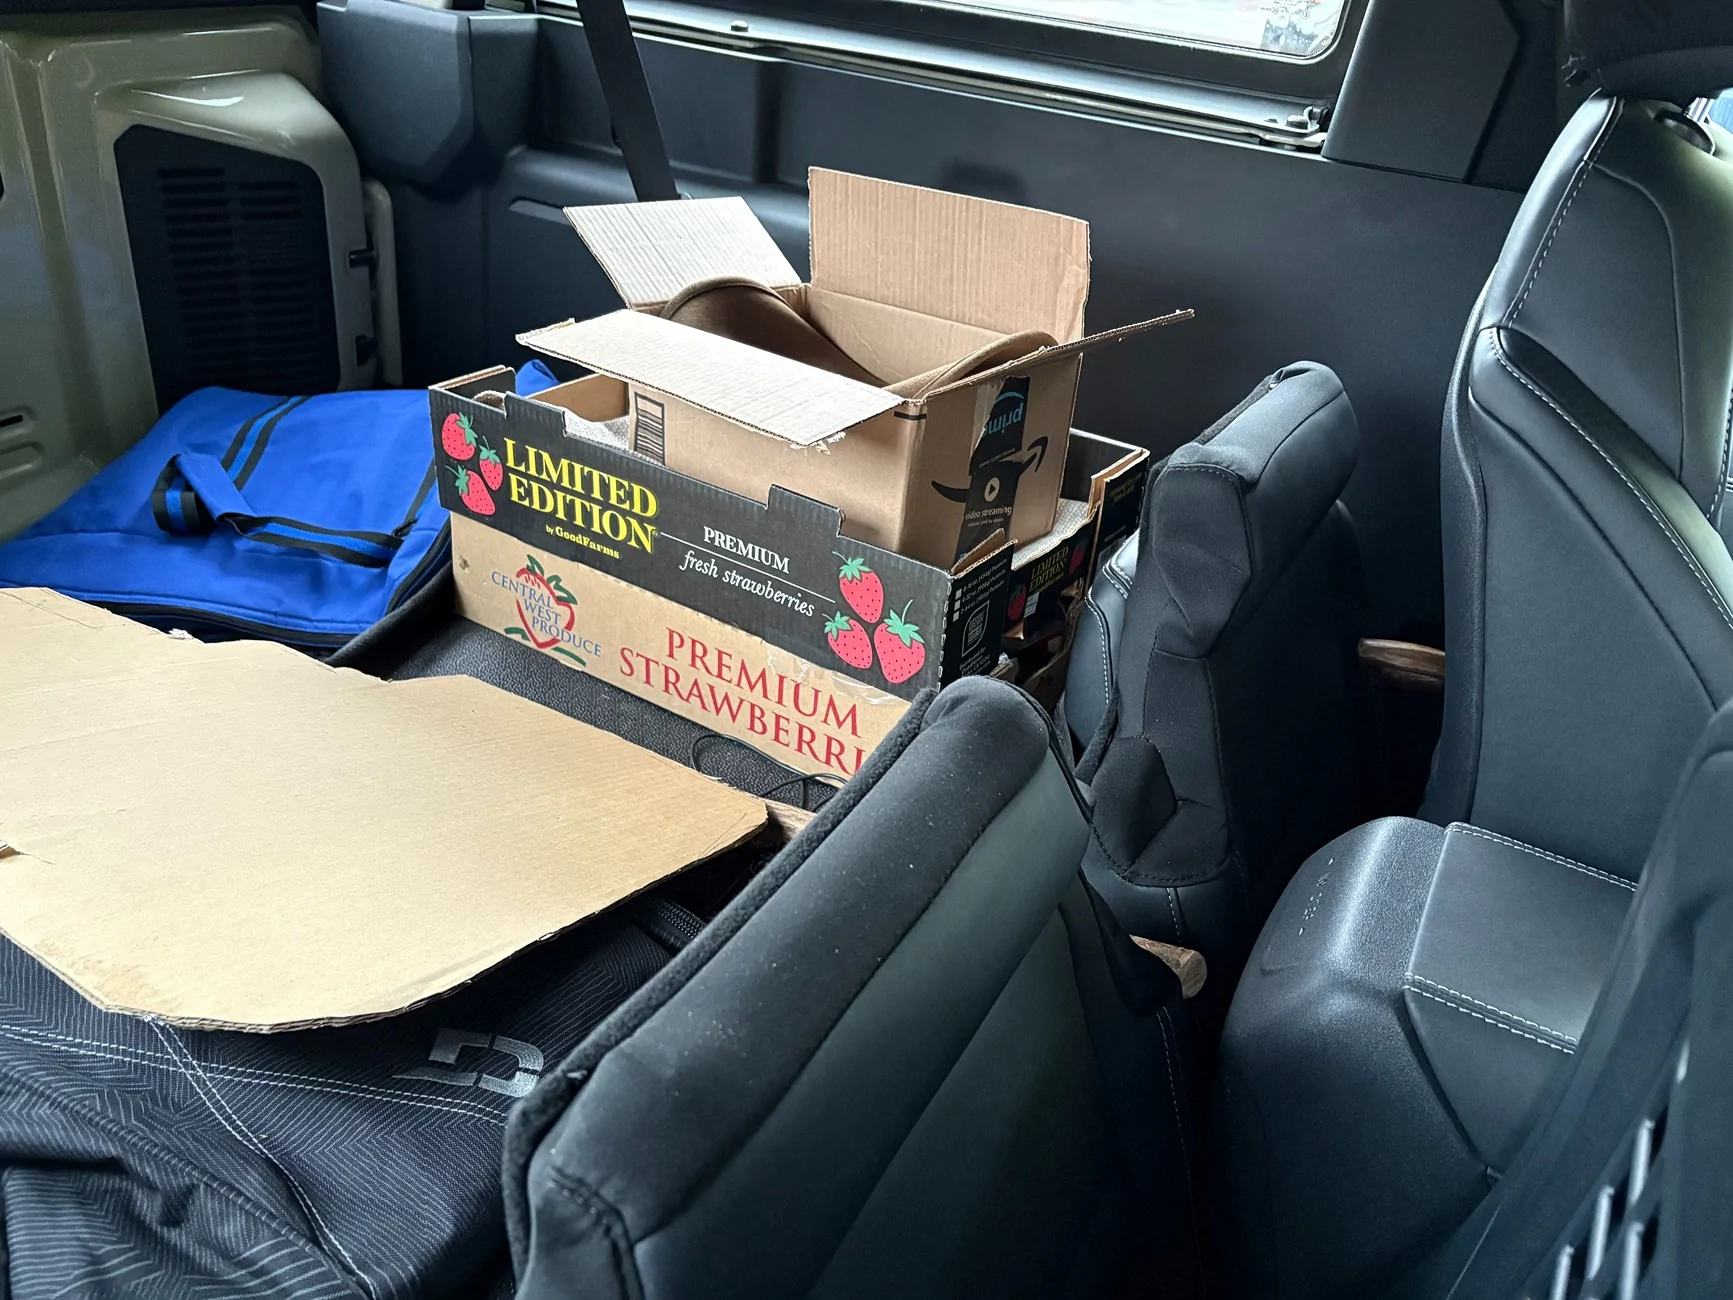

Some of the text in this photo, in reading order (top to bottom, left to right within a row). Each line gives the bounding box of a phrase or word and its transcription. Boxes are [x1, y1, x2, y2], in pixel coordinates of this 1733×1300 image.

[504, 437, 659, 518] LIMITED
[508, 472, 657, 554] EDITION
[981, 504, 1012, 518] streaming
[545, 525, 620, 559] by GoodFarms
[703, 525, 790, 574] PREMIUM
[1029, 559, 1066, 593] EDITION
[1031, 546, 1069, 579] LIMITED
[492, 571, 554, 610] CENTRAL
[679, 550, 815, 617] fresh strawberries
[523, 598, 562, 625] WEST
[532, 616, 601, 657] PRODUCE
[665, 627, 863, 739] PREMIUM
